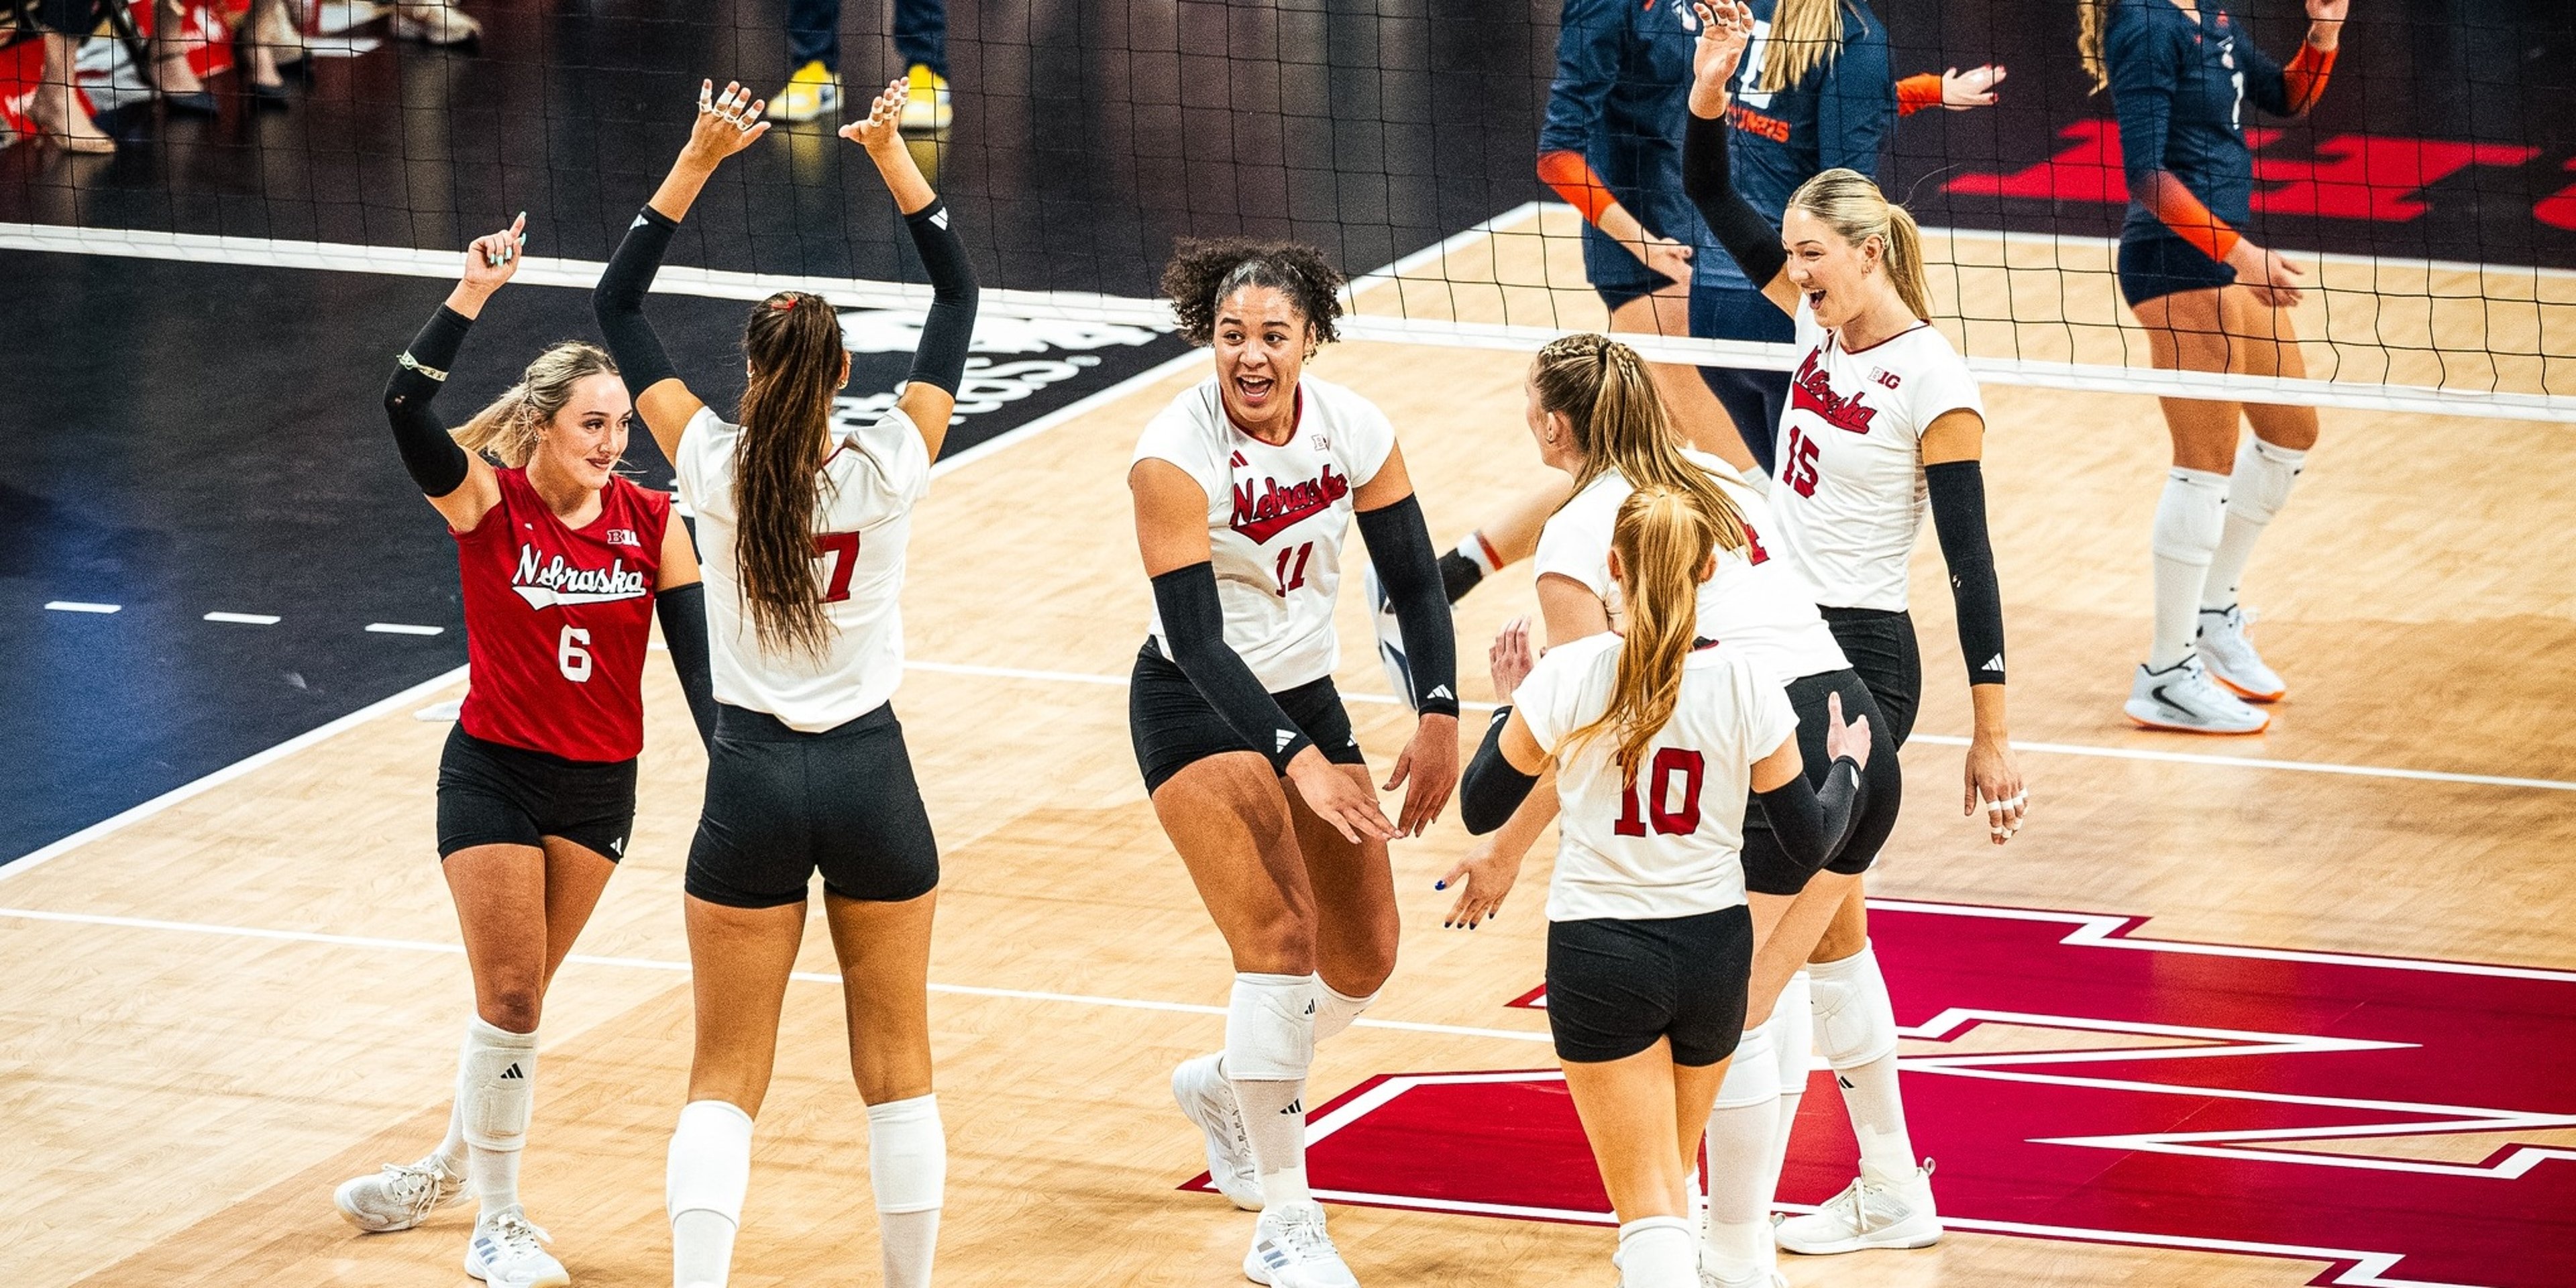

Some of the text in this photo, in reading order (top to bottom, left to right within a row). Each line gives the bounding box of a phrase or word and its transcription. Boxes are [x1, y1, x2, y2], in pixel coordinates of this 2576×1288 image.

[1782, 425, 1820, 499] 15
[1228, 464, 1349, 528] Nebraska
[511, 543, 647, 597] Nebraska
[1276, 541, 1313, 598] 11
[558, 624, 592, 683] 6
[1614, 747, 1705, 838] 10
